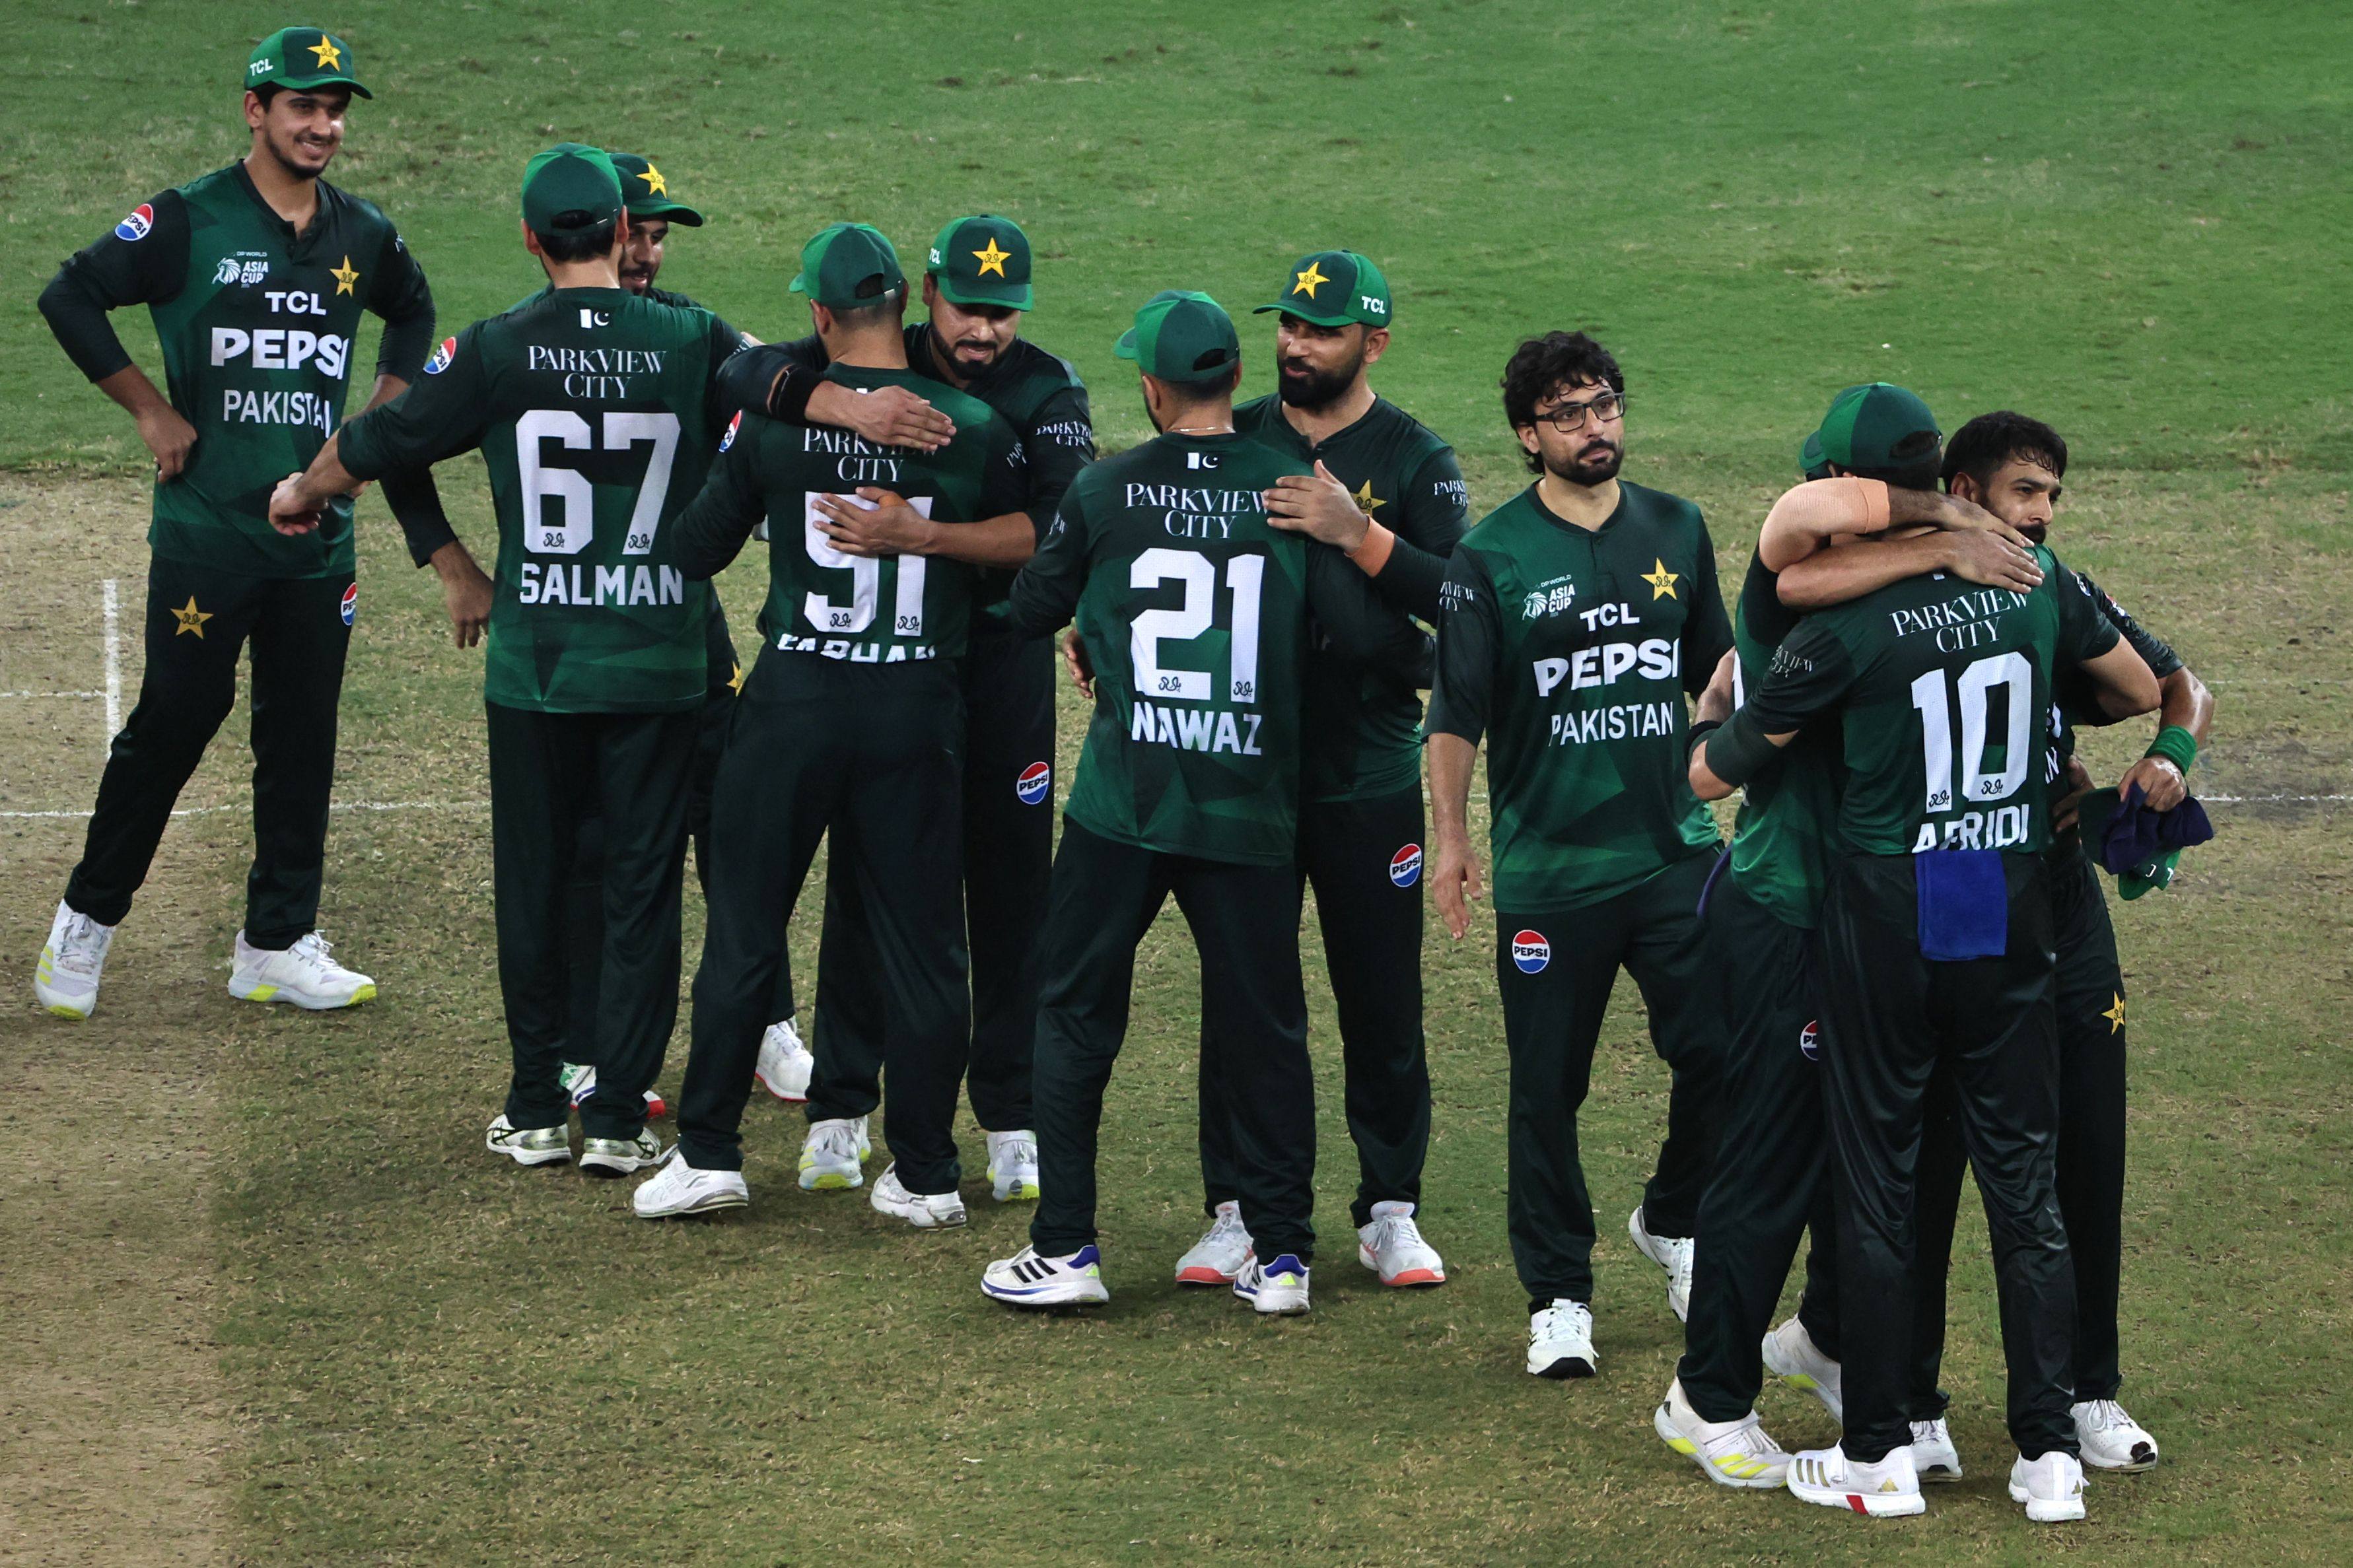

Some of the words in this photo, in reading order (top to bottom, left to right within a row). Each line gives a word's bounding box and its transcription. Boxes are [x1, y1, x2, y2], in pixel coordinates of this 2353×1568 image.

[250, 58, 273, 76] TCL
[240, 272, 263, 284] CUP
[242, 261, 269, 273] ASIA
[265, 290, 327, 316] TCL
[1361, 295, 1386, 314] TCL
[211, 327, 349, 380] PEPSI
[527, 345, 667, 374] PARKVIEW
[565, 372, 631, 398] CITY
[515, 409, 681, 555] 67
[837, 456, 903, 483] CITY
[1164, 510, 1237, 539] CITY
[804, 491, 933, 636] 91
[519, 562, 683, 606] SALMAN
[1549, 574, 1572, 585] WORLD
[1549, 584, 1576, 602] ASIA
[1549, 596, 1572, 613] CUP
[1579, 603, 1640, 632] TCL
[1888, 588, 2027, 637] PARKVIEW
[1130, 548, 1265, 704] 21
[1936, 615, 2002, 653] CITY
[1533, 637, 1680, 697] PEPSI
[1131, 701, 1262, 756] NAWAZ
[1548, 700, 1673, 747] PAKISTAN
[1911, 650, 2032, 813] 10
[1019, 773, 1048, 792] PEPSI
[1911, 803, 2029, 854] AFRIDI
[1392, 855, 1421, 875] PEPSI
[1514, 945, 1548, 957] PEPSI
